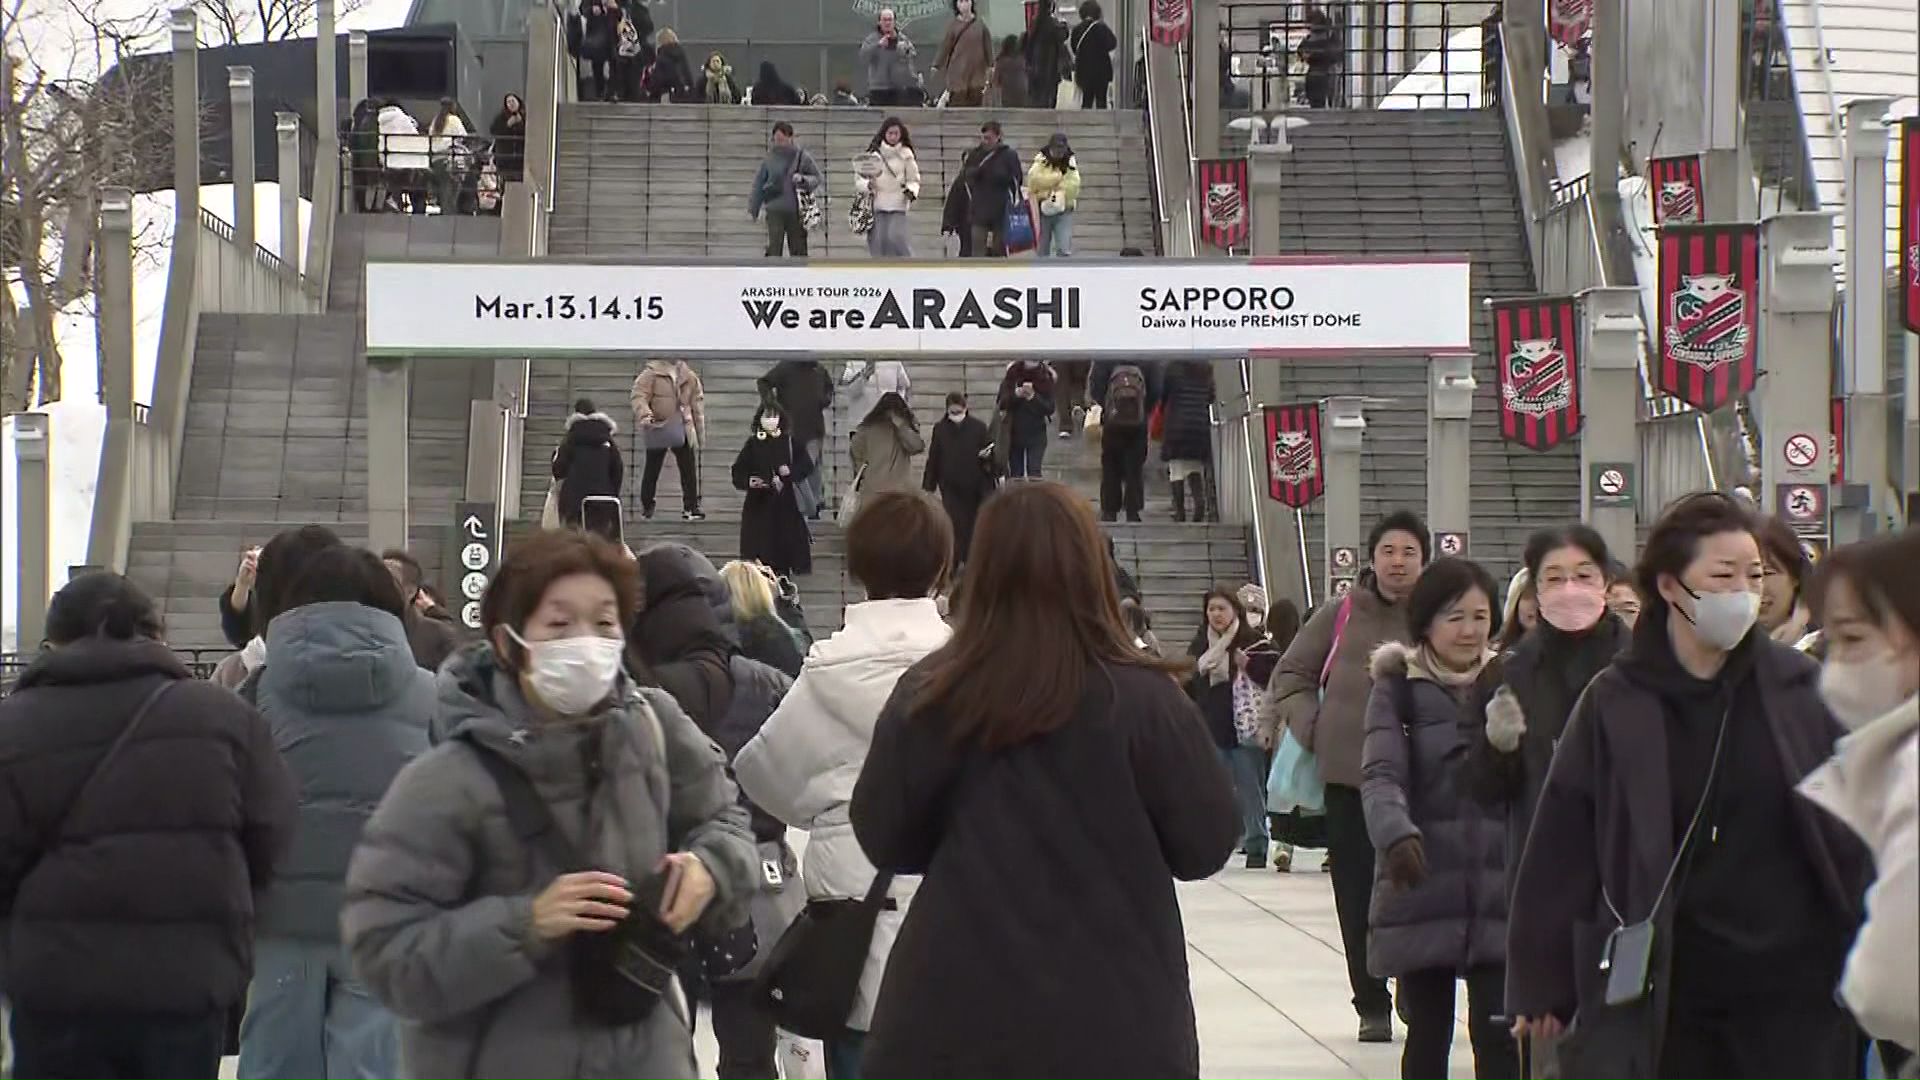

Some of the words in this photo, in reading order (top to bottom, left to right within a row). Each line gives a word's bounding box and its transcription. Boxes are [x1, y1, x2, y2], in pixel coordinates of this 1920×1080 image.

[741, 287, 786, 297] ARASHI
[788, 287, 814, 297] LIVE
[816, 287, 850, 297] TOUR
[852, 287, 882, 297] 2026
[1139, 286, 1295, 312] SAPPORO
[475, 294, 664, 321] Mar.13.14.15
[741, 299, 800, 330] We
[808, 308, 865, 330] are
[869, 286, 1081, 330] ARASHI
[1678, 301, 1703, 320] CS
[1141, 315, 1186, 329] Daiwa
[1191, 315, 1237, 329] House
[1241, 314, 1309, 328] PREMIST
[1312, 313, 1361, 327] DOME
